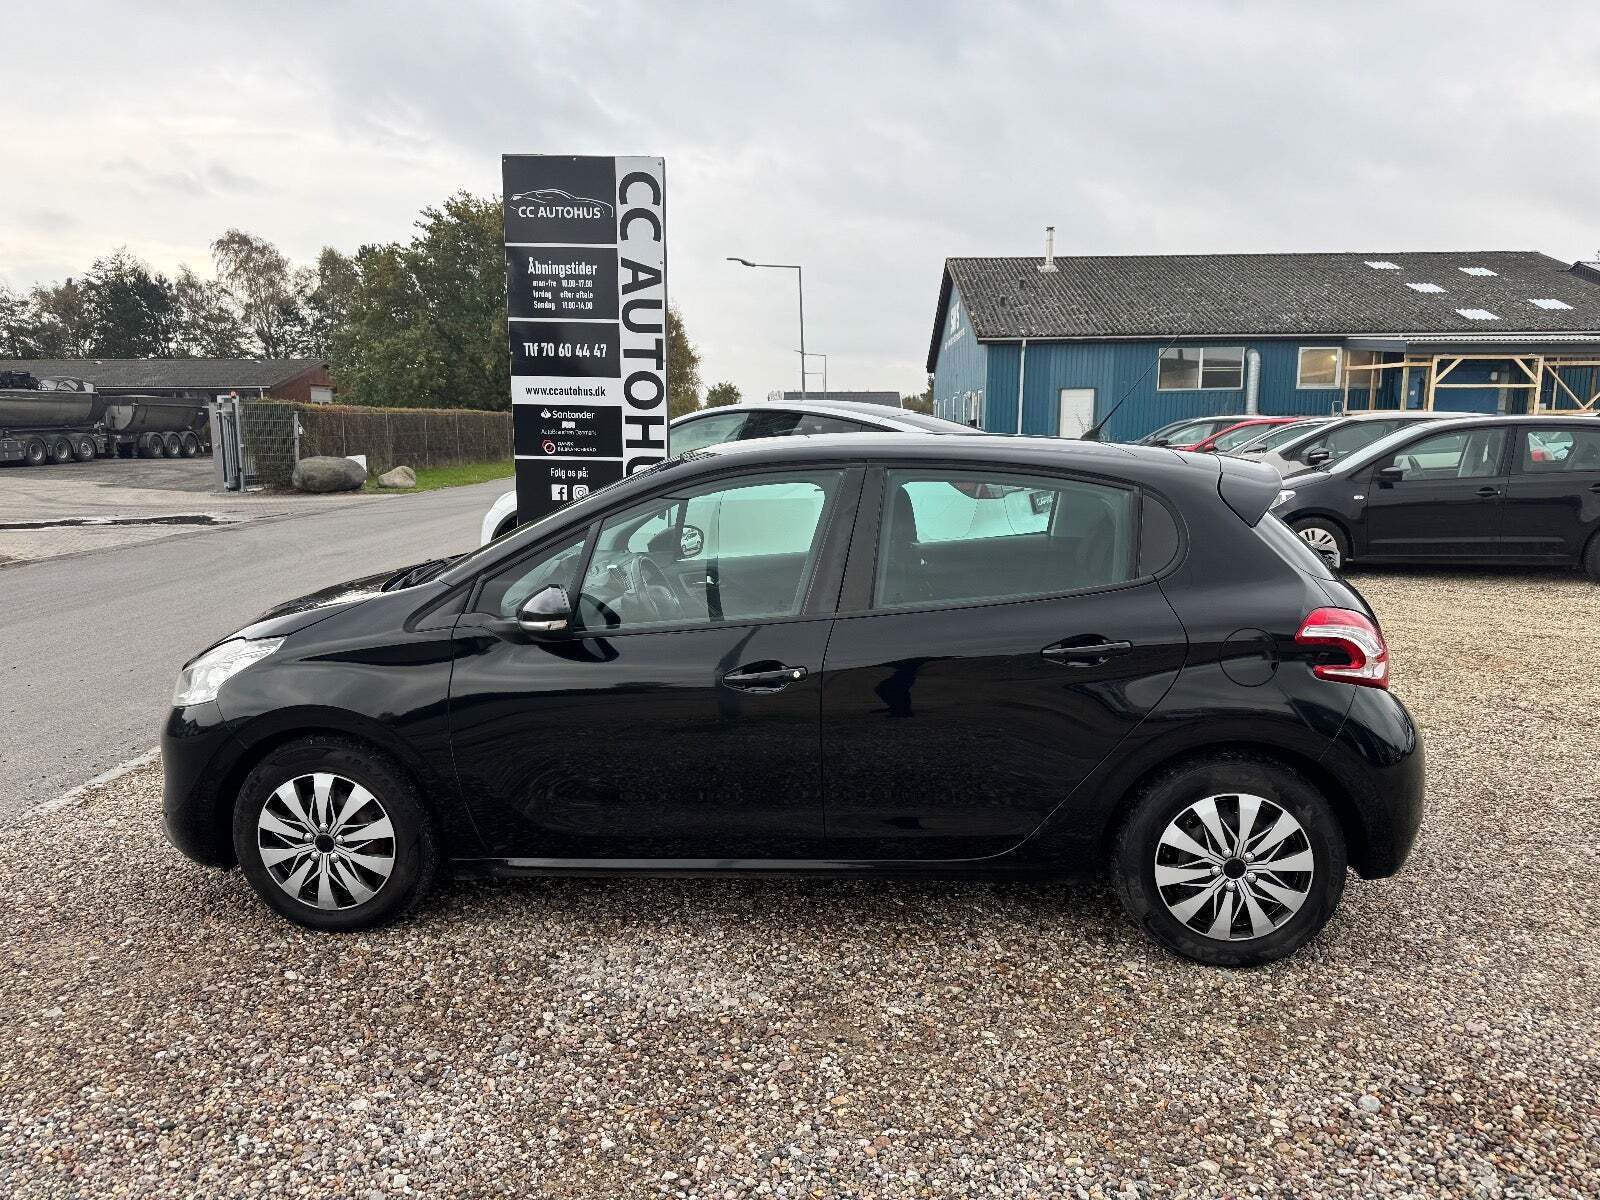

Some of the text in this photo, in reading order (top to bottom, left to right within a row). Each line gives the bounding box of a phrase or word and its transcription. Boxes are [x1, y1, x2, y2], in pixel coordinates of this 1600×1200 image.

[518, 206, 601, 218] CC AUTOHUS
[619, 171, 661, 243] CC
[527, 257, 598, 278] Åbningstider
[560, 290, 575, 299] efter
[523, 342, 607, 358] Tlf 70 60 44 47
[525, 386, 606, 397] www.ccautohus.dk
[552, 410, 595, 419] Santander
[550, 467, 566, 479] Følg
[577, 466, 589, 479] på:
